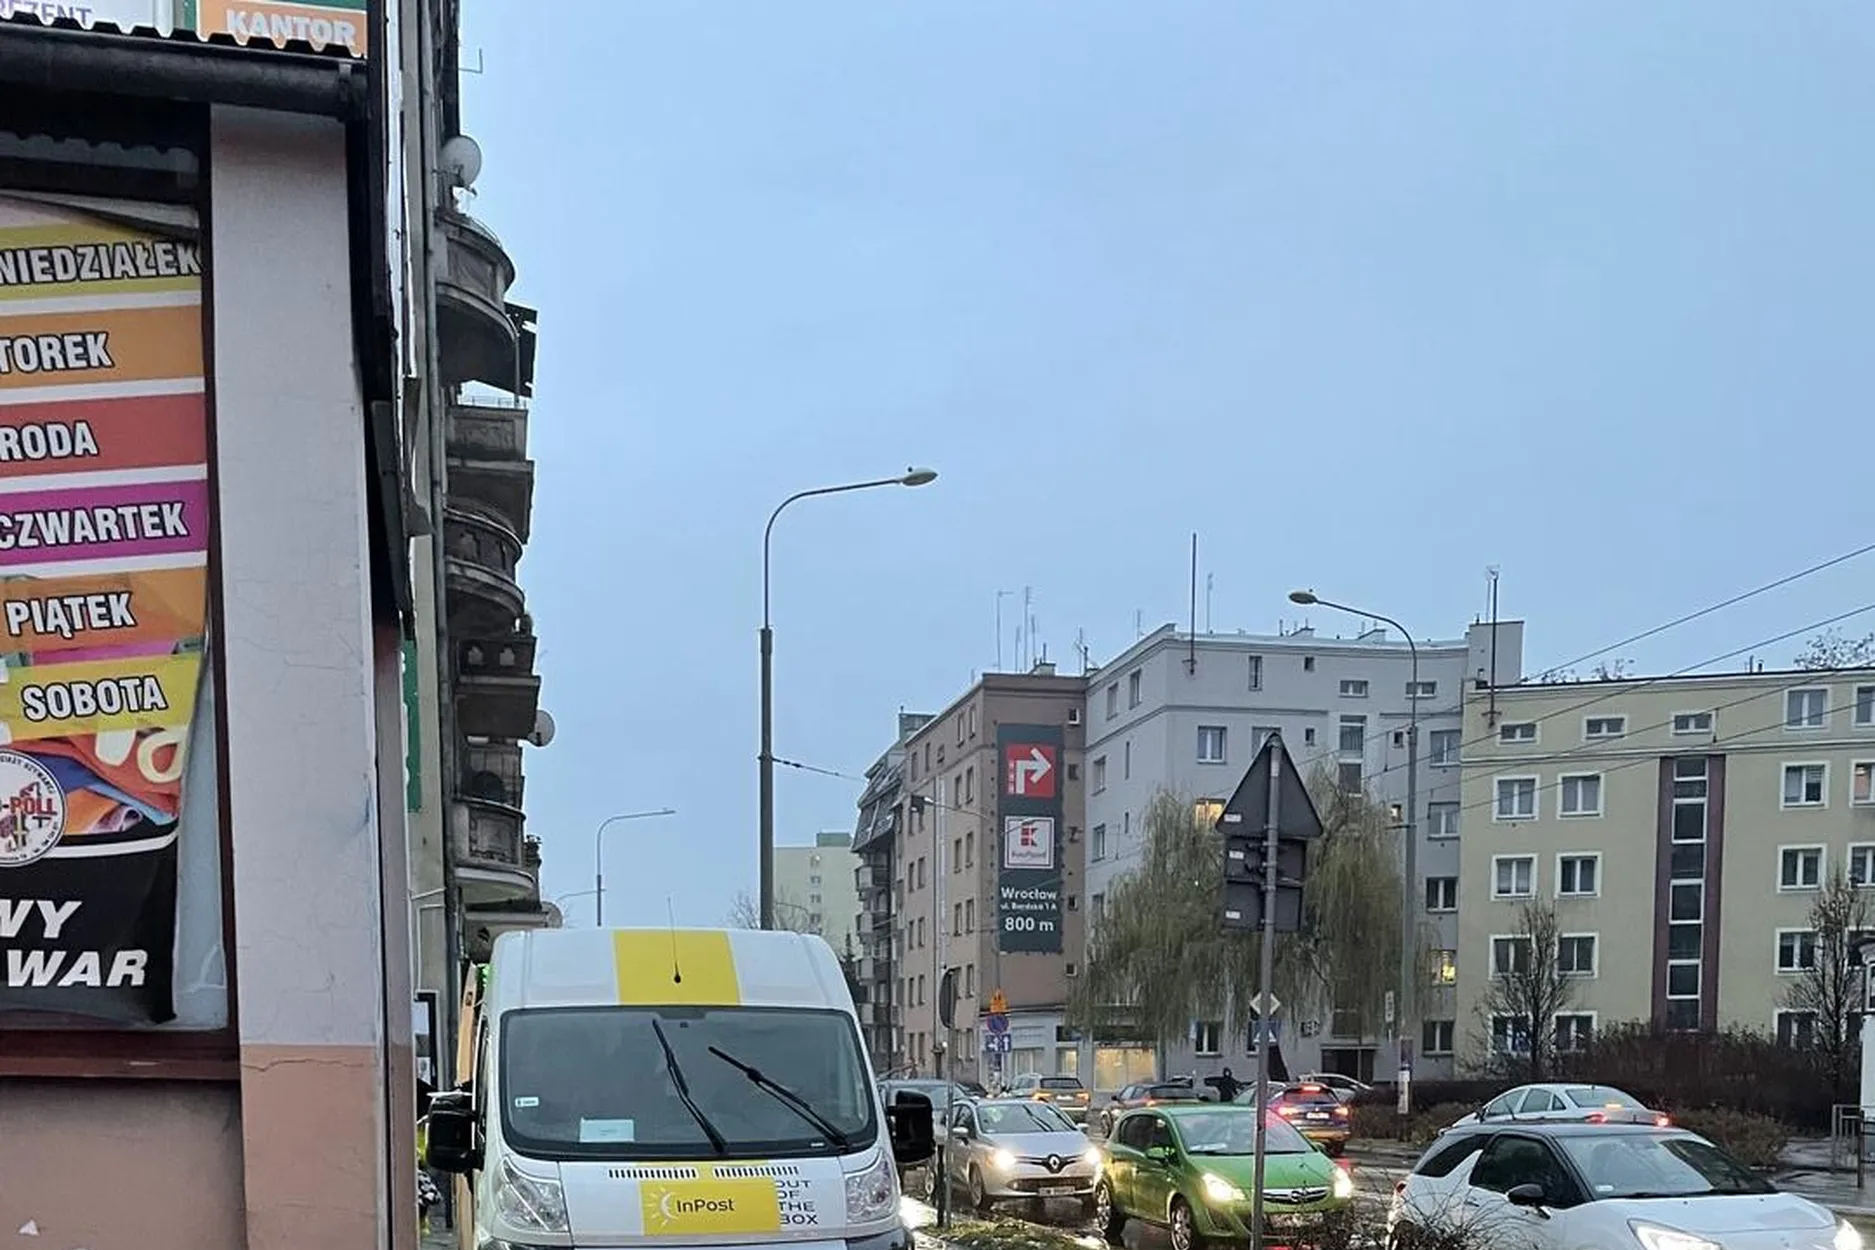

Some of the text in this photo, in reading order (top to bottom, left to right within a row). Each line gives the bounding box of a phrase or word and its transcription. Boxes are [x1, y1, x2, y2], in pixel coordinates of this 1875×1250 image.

[226, 8, 356, 44] KANTOR
[5, 591, 138, 639] PIĄTEK
[22, 675, 169, 722] SOBOTA
[1005, 916, 1054, 931] 800 m
[7, 950, 148, 987] WAR
[676, 1198, 734, 1213] InPost
[778, 1200, 815, 1212] THE
